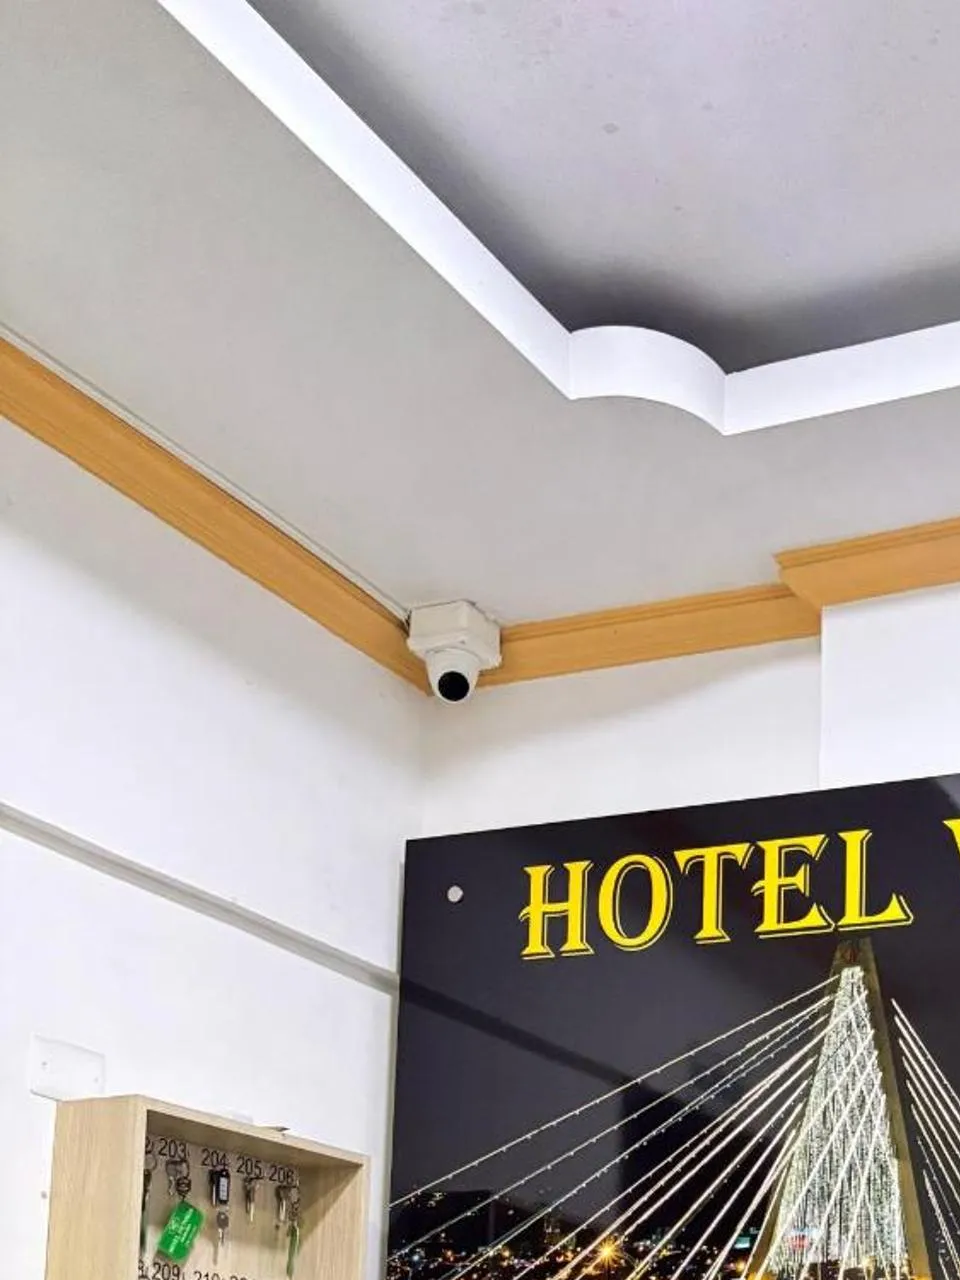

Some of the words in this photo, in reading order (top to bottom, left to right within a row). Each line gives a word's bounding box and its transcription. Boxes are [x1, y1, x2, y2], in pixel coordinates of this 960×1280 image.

[518, 829, 913, 960] HOTEL
[159, 1138, 187, 1160] 203
[201, 1148, 228, 1168] 204
[236, 1156, 262, 1177] 205
[269, 1165, 295, 1183] 206
